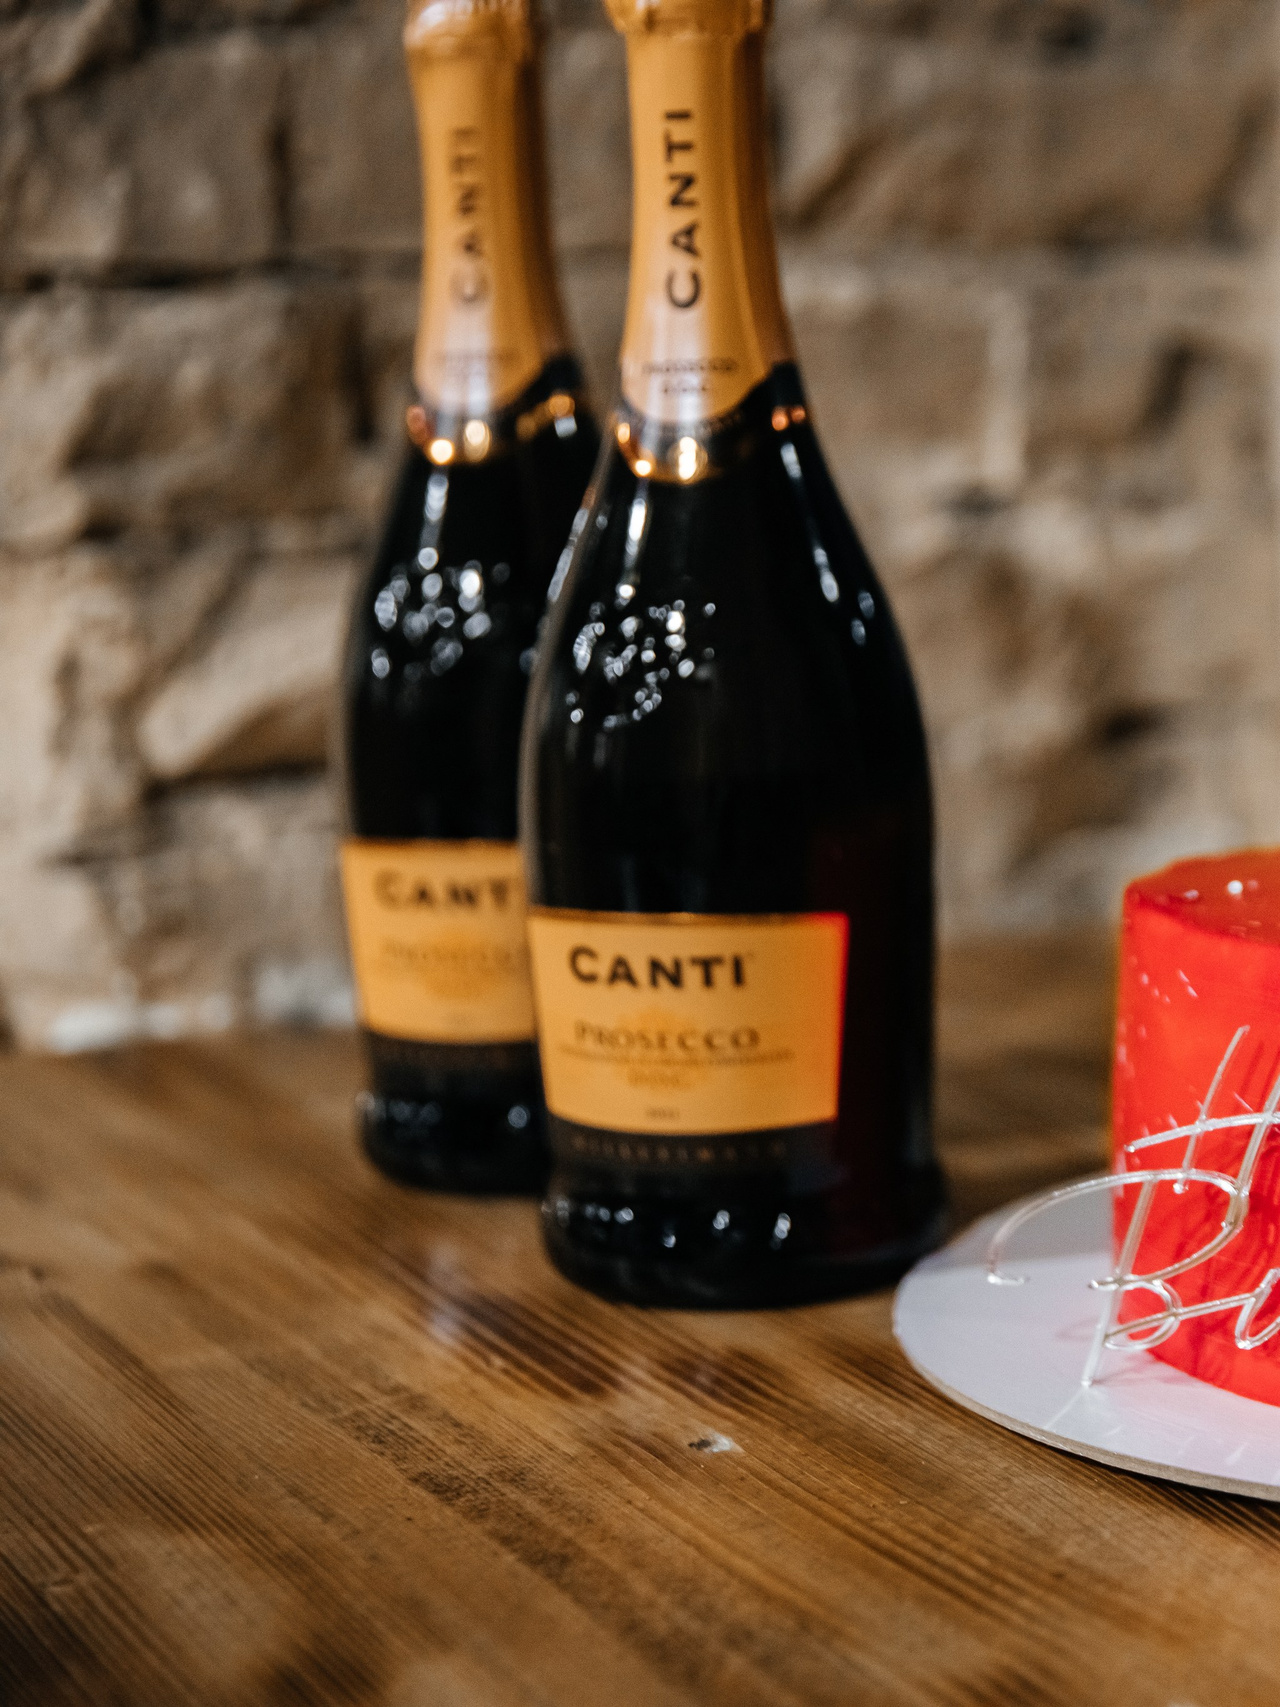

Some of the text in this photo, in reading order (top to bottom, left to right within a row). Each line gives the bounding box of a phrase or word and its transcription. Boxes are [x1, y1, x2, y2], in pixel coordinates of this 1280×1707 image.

[451, 124, 490, 308] CANTI
[664, 108, 702, 309] CANTI
[372, 864, 522, 912] CANT
[567, 945, 745, 989] CANTI
